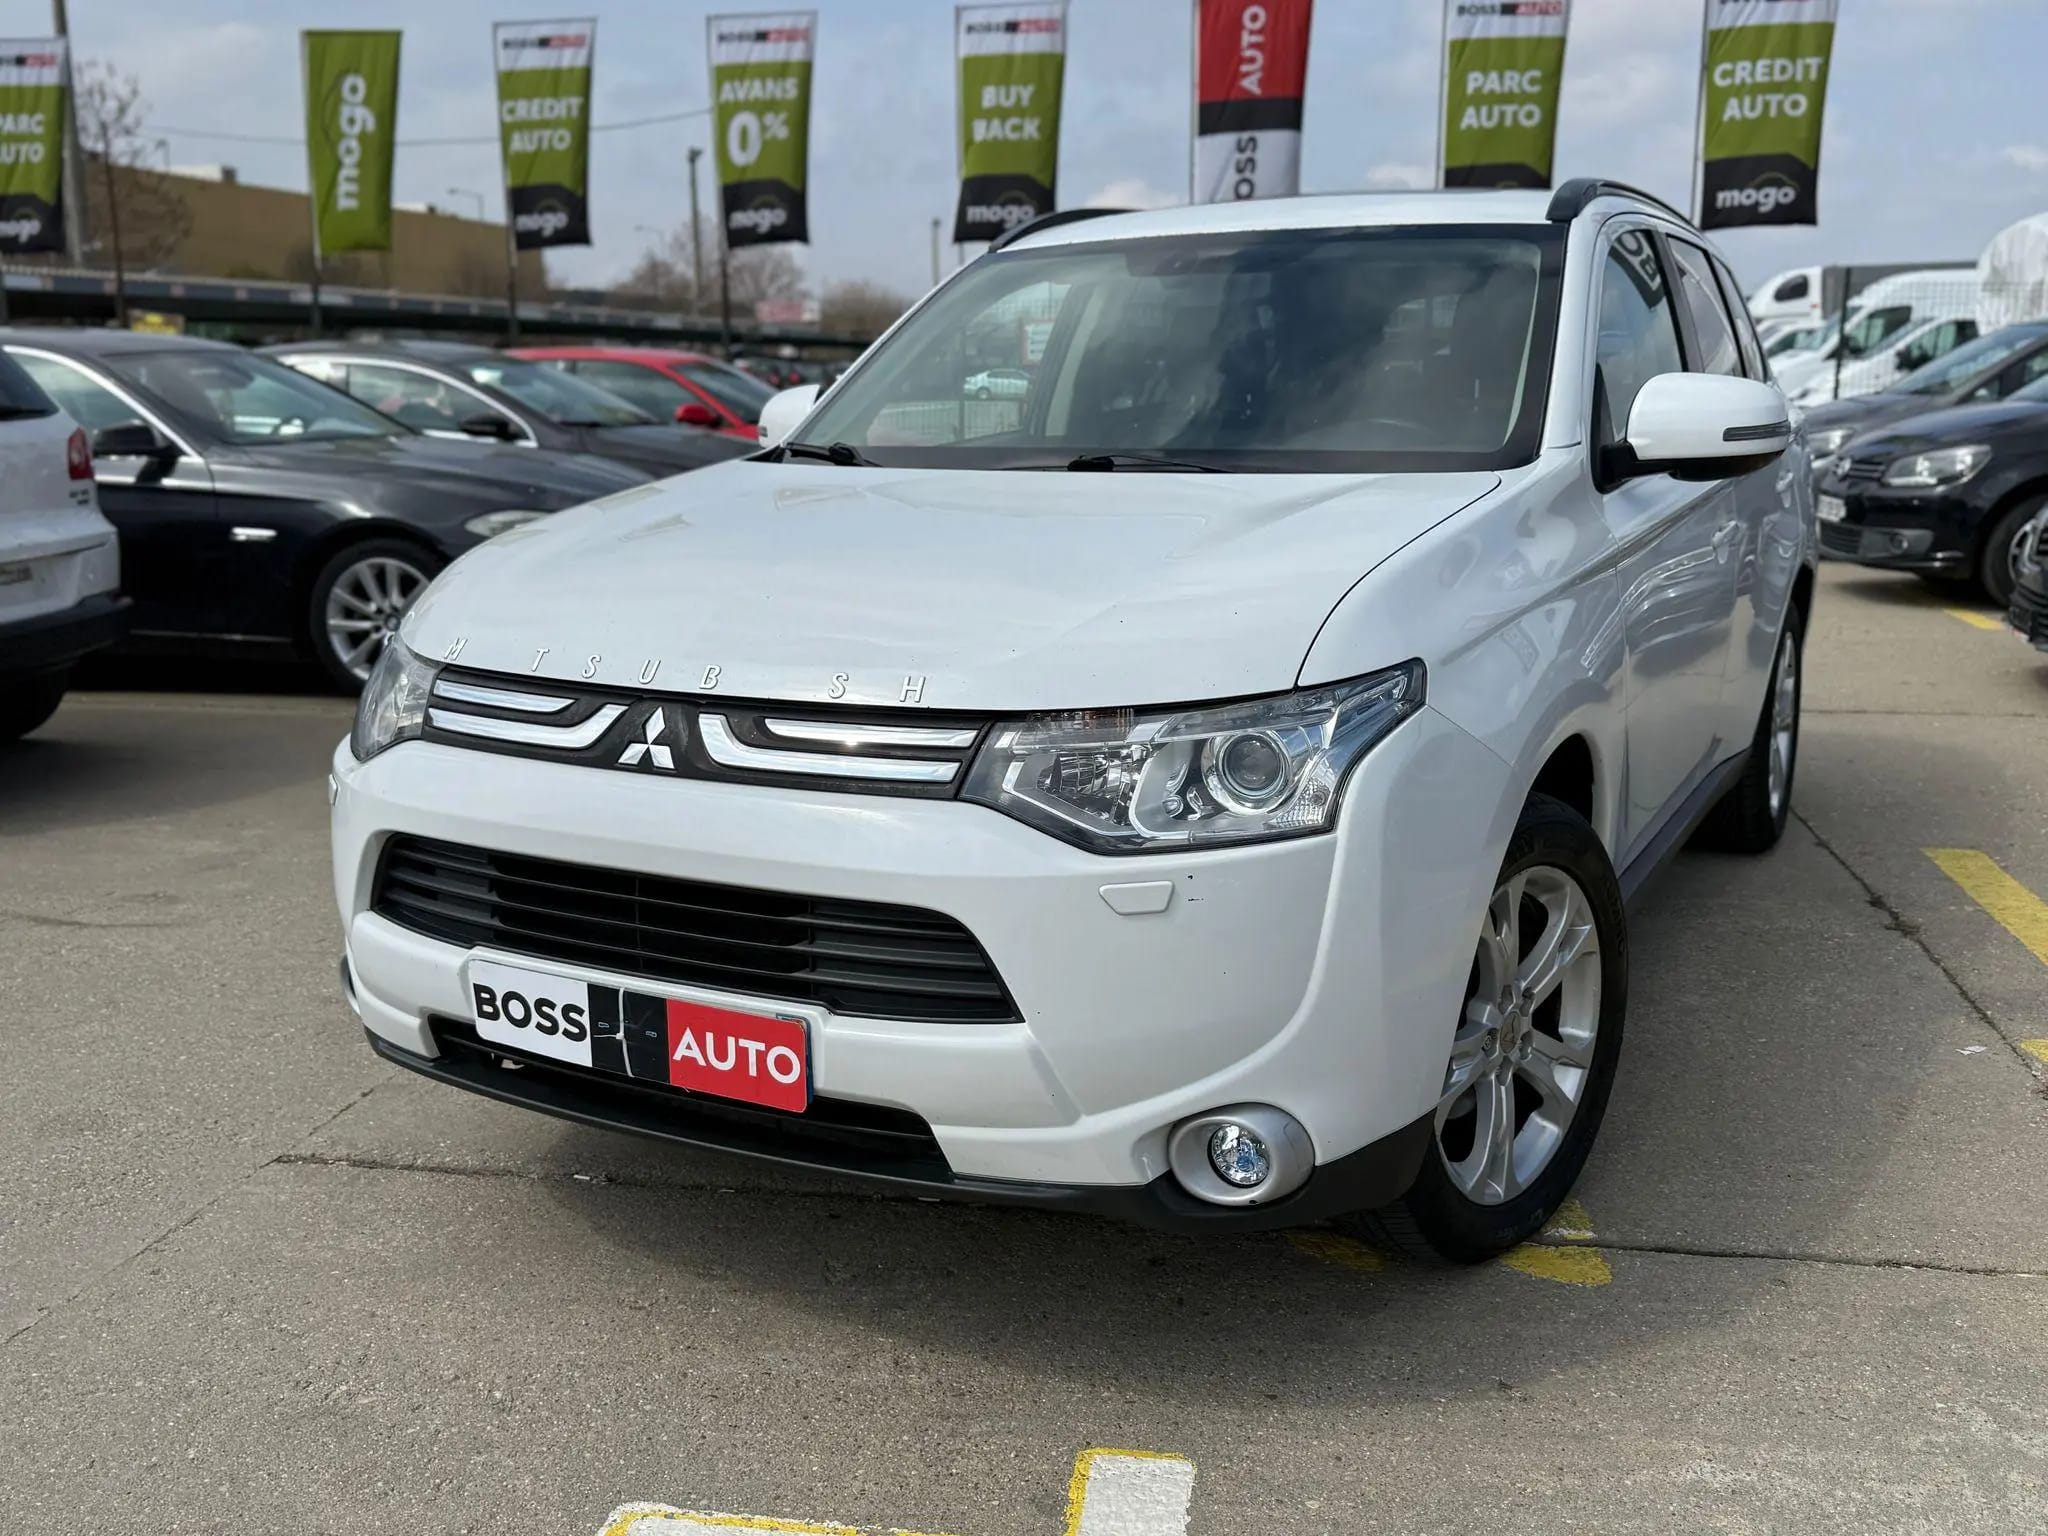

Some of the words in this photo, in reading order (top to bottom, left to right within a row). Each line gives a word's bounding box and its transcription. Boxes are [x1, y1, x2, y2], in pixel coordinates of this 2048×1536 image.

[1237, 4, 1267, 95] AUTO
[1466, 69, 1542, 95] PARC
[1713, 57, 1823, 87] CREDIT
[720, 76, 797, 102] AVANS
[981, 84, 1035, 108] BUY
[502, 97, 583, 122] CREDIT
[1460, 103, 1542, 130] AUTO
[1722, 93, 1808, 121] AUTO
[336, 72, 376, 211] mogo
[510, 128, 571, 154] AUTO
[727, 110, 790, 167] 0%
[972, 117, 1041, 143] BACK
[0, 140, 45, 164] UTO
[1234, 135, 1258, 200] OSS
[1715, 185, 1796, 213] mogo
[966, 204, 1036, 230] mogo
[473, 982, 588, 1043] BOSS
[672, 1027, 801, 1085] AUTO
